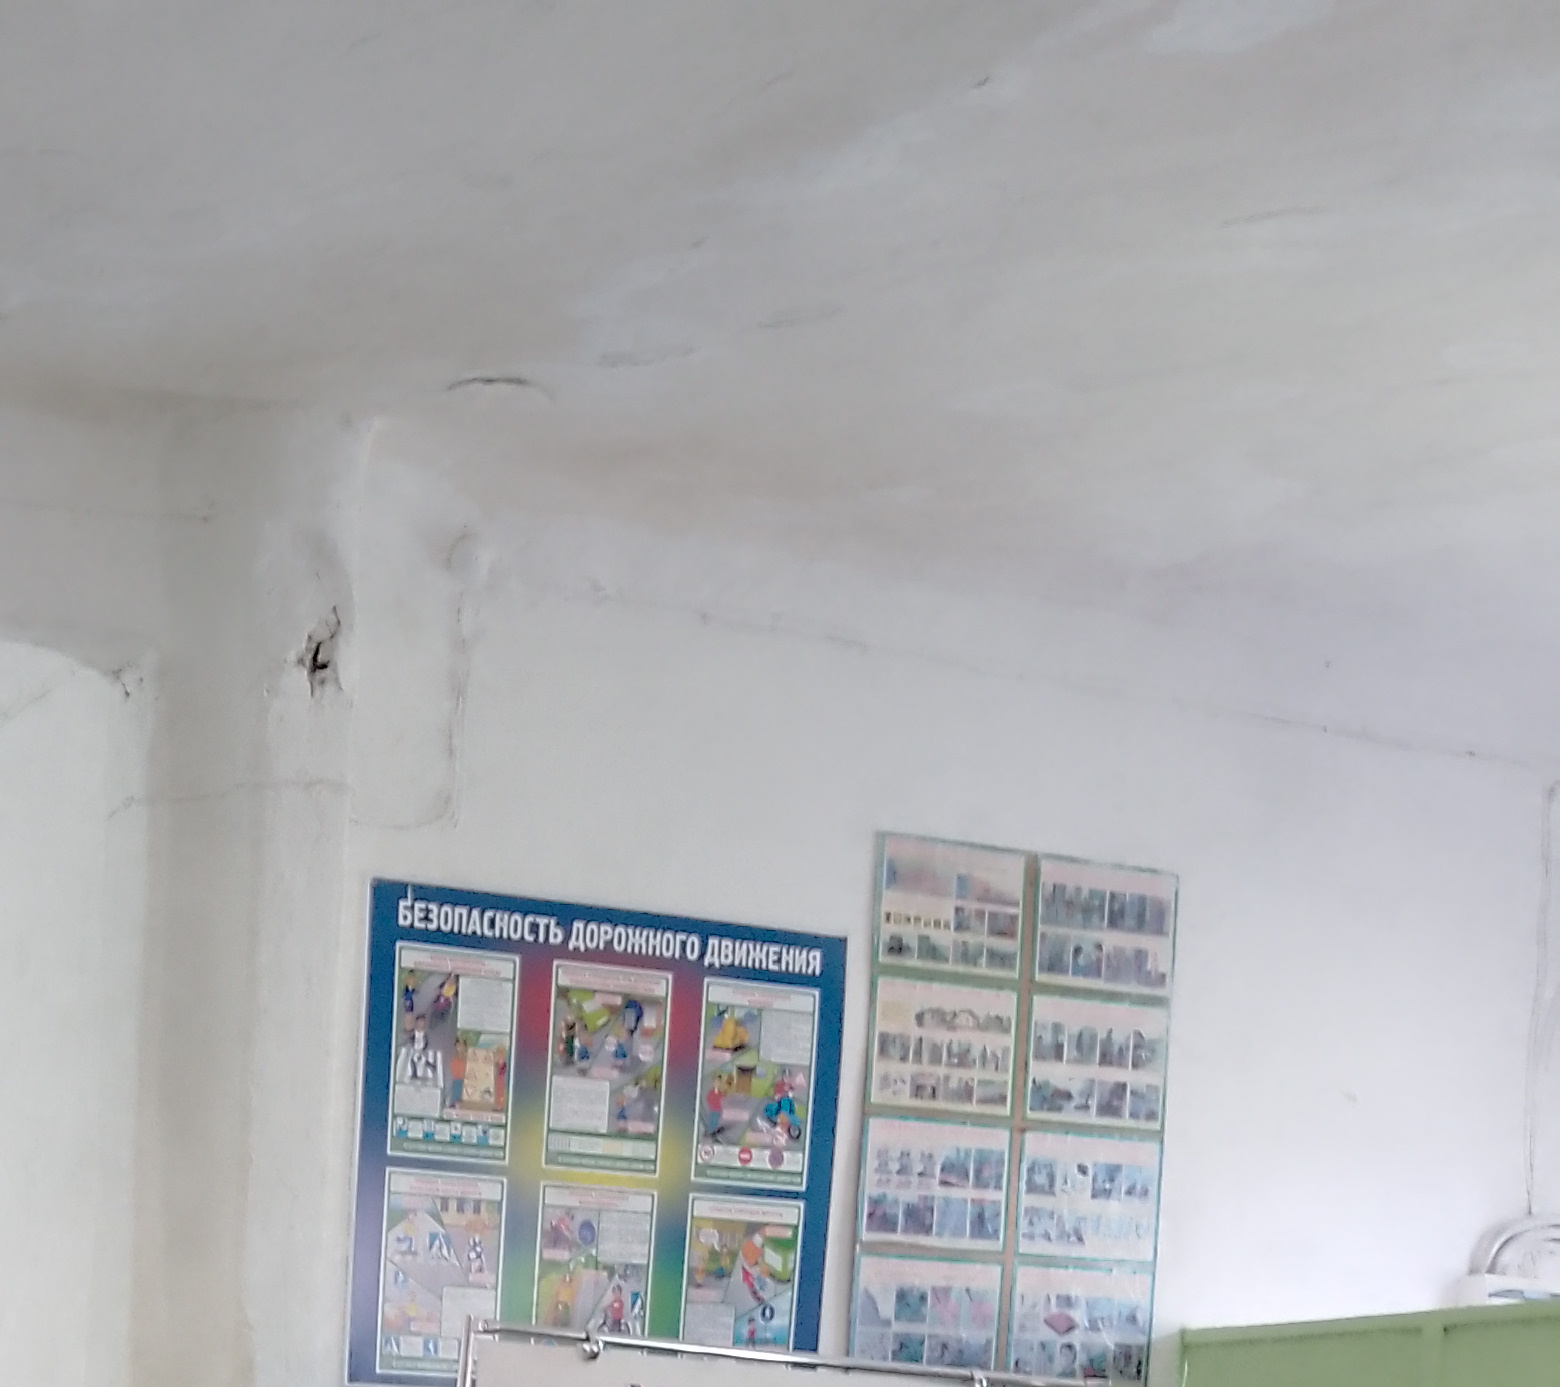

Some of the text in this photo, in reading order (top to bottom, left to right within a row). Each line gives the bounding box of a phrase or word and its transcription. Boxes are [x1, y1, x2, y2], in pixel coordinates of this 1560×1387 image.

[396, 899, 822, 977] БЕЗОПАСНОСТЬ ДОРОЖНОГО ДВИЖЕНИЯ
